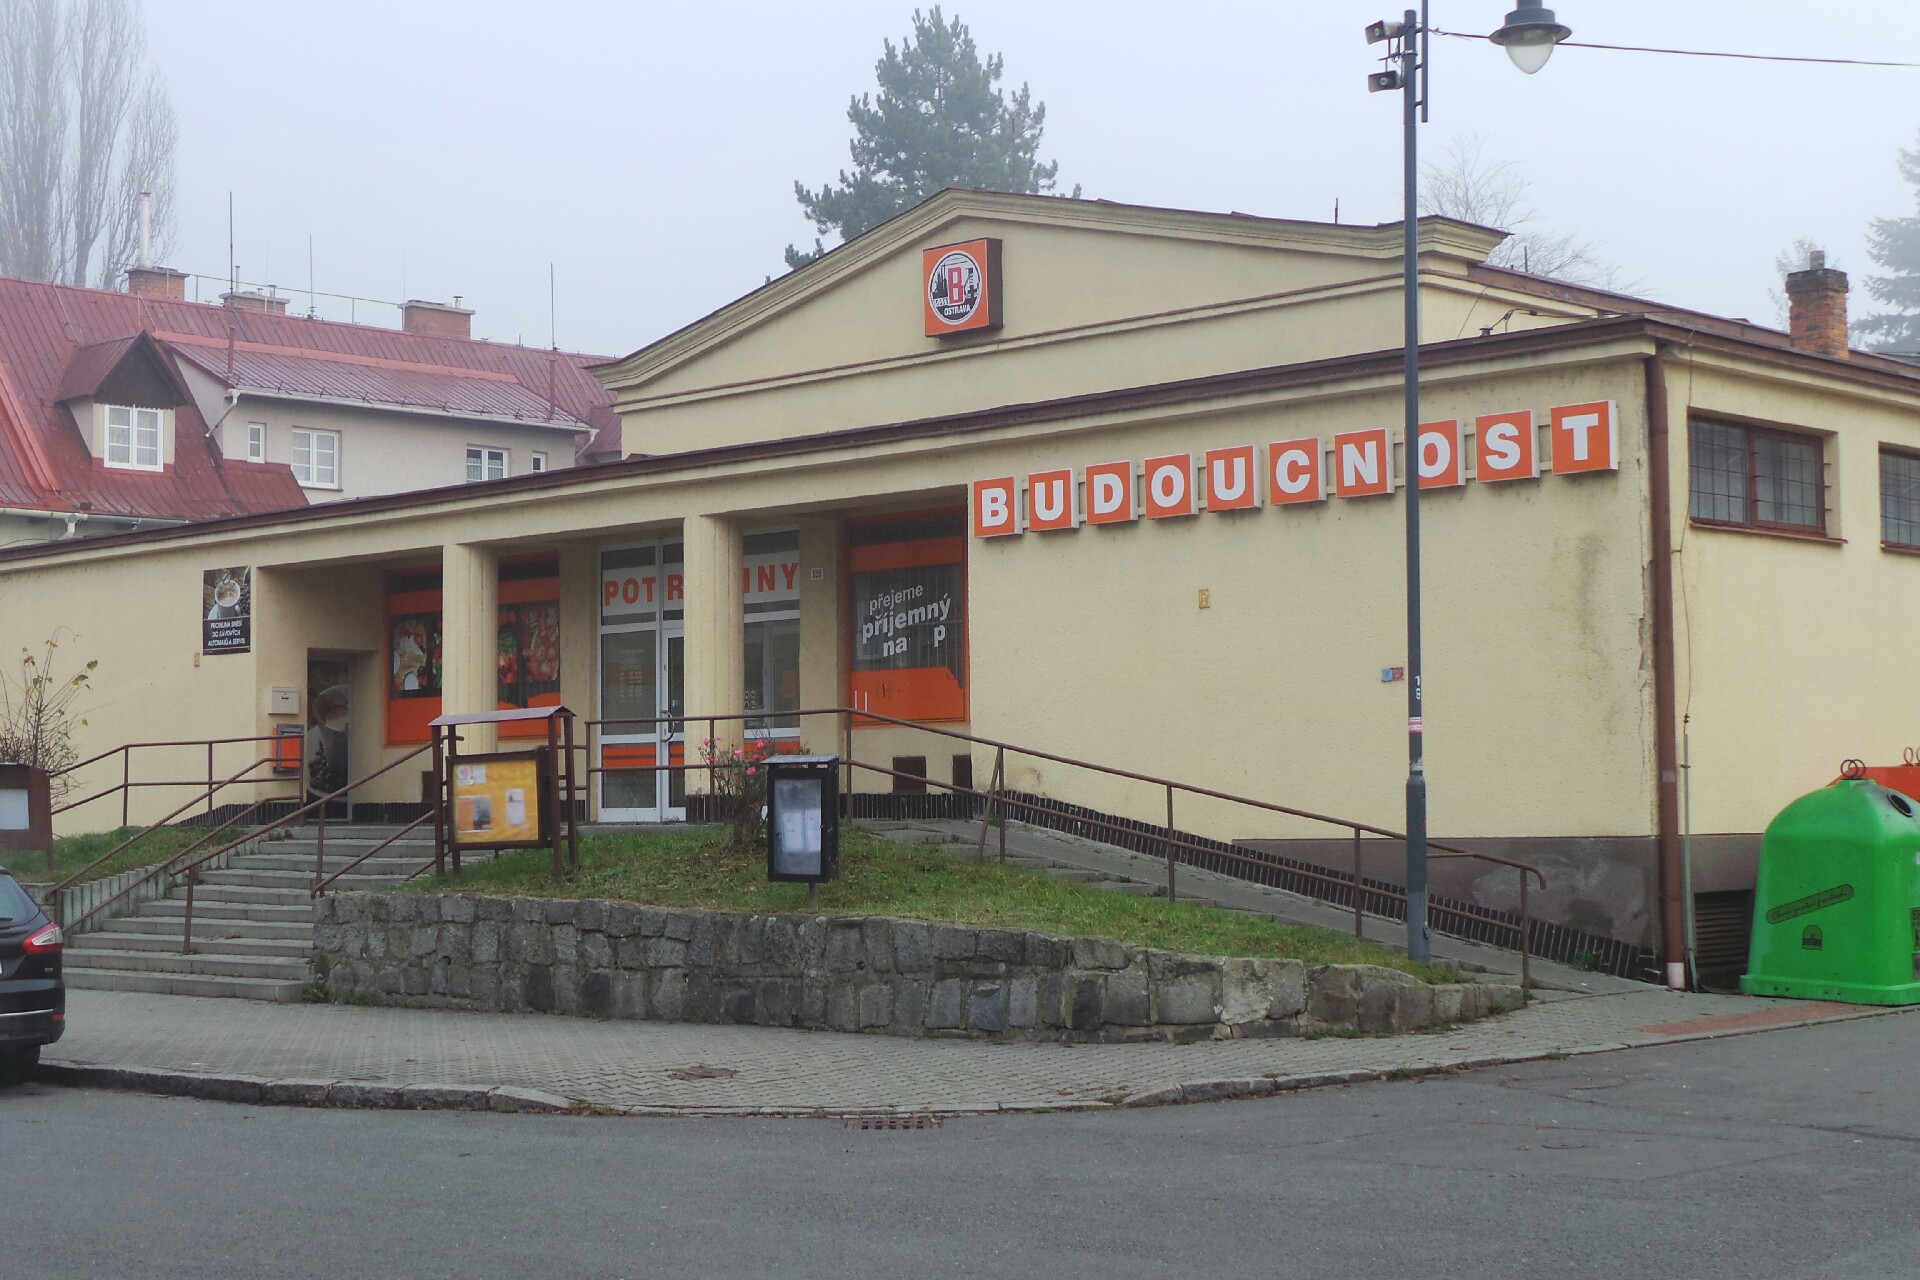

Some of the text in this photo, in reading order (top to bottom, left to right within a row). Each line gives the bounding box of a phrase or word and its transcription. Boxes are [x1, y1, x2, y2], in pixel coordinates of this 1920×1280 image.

[944, 304, 971, 316] OSTRAVA
[981, 412, 1599, 528] BUDOUCNOST
[862, 593, 951, 644] příjemný
[869, 585, 923, 615] přejeme
